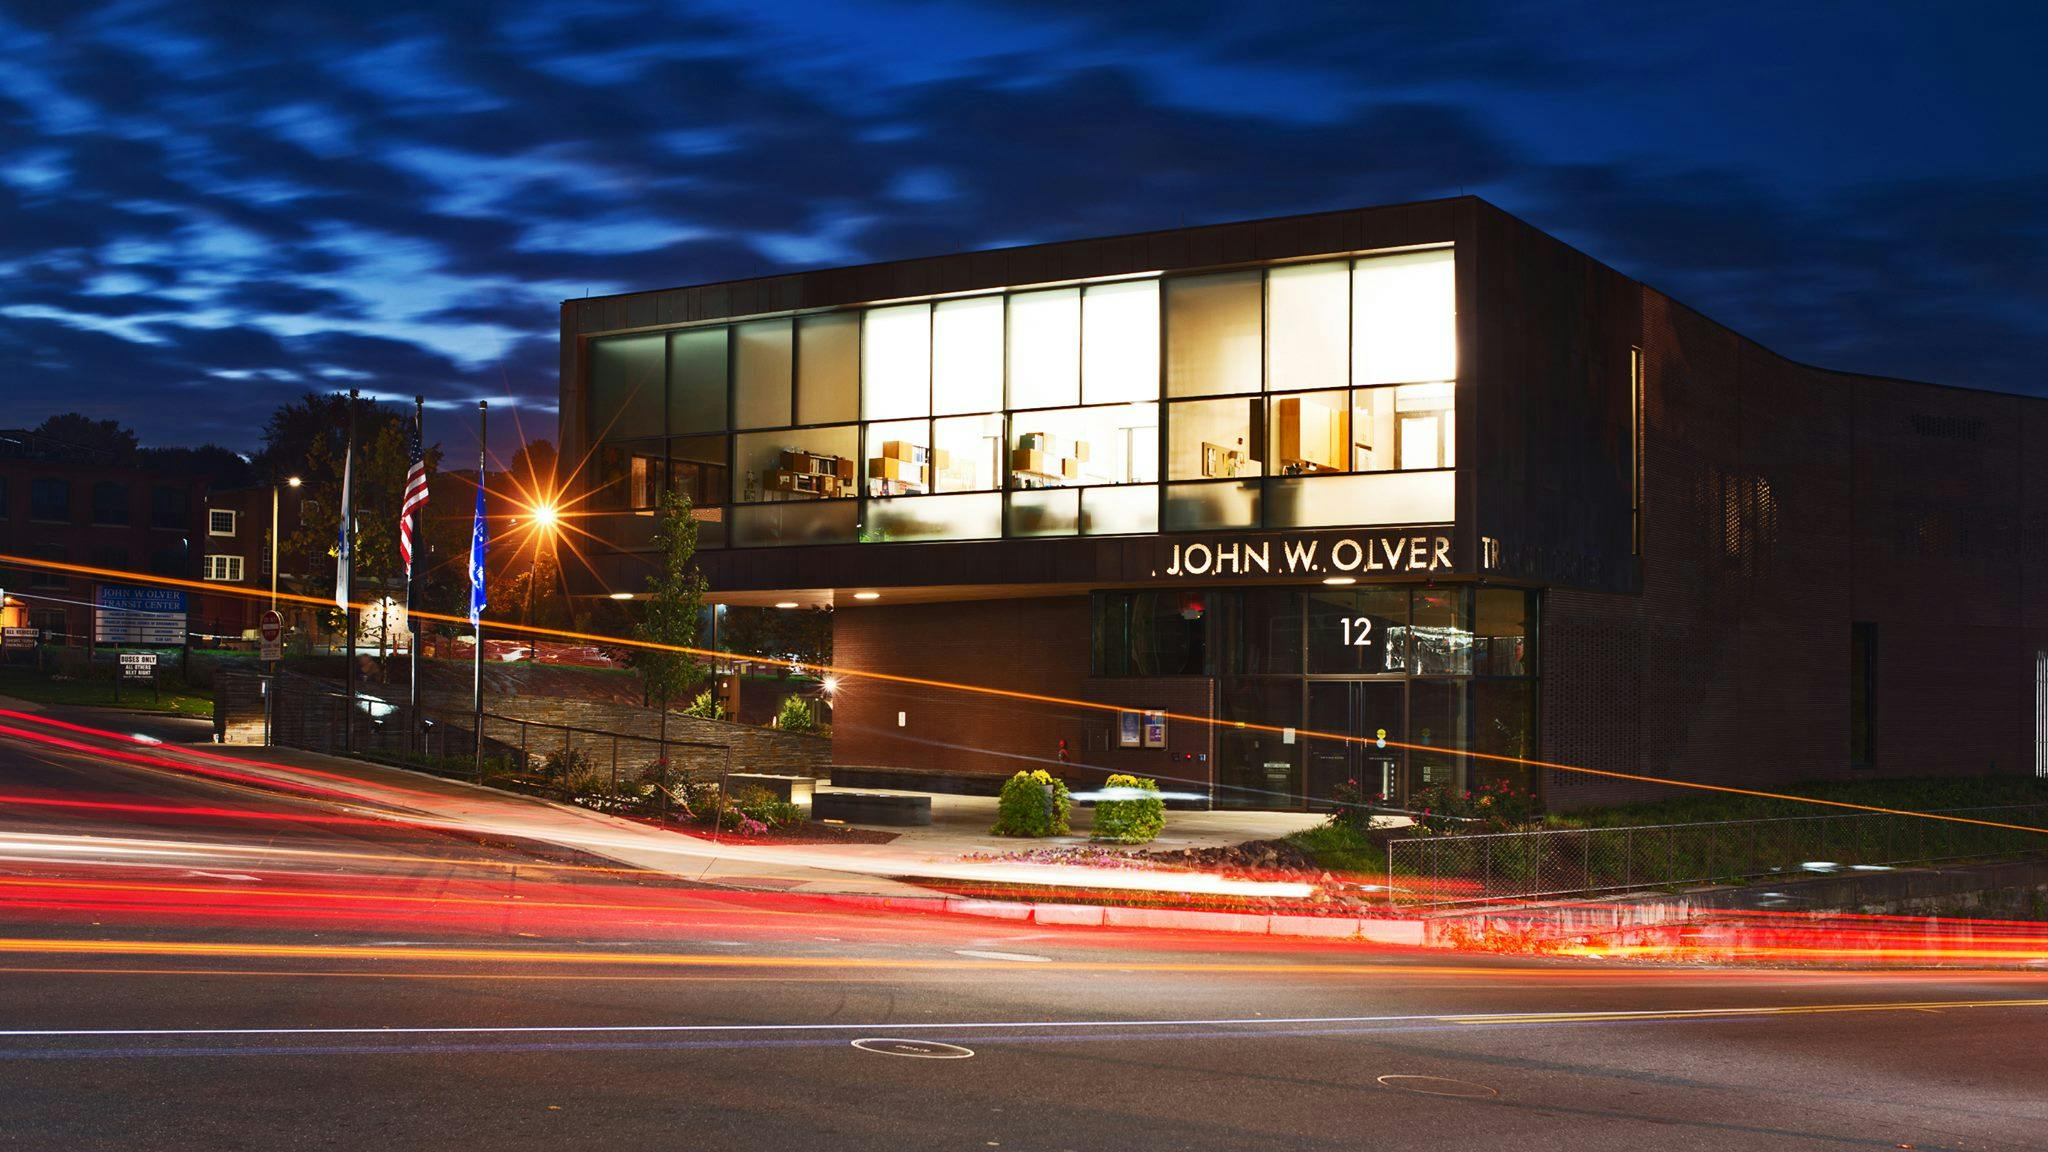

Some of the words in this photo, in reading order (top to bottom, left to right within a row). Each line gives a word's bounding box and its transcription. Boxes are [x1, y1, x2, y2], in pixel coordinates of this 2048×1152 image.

[1166, 541, 1269, 575] JOHN
[1284, 540, 1319, 572] W.
[1331, 536, 1452, 572] OLVER
[103, 588, 130, 598] JOHN
[134, 589, 145, 598] W
[147, 590, 180, 600] OLVER
[104, 600, 142, 609] TRANSIT
[145, 601, 180, 610] CENTER
[1340, 617, 1372, 646] 12
